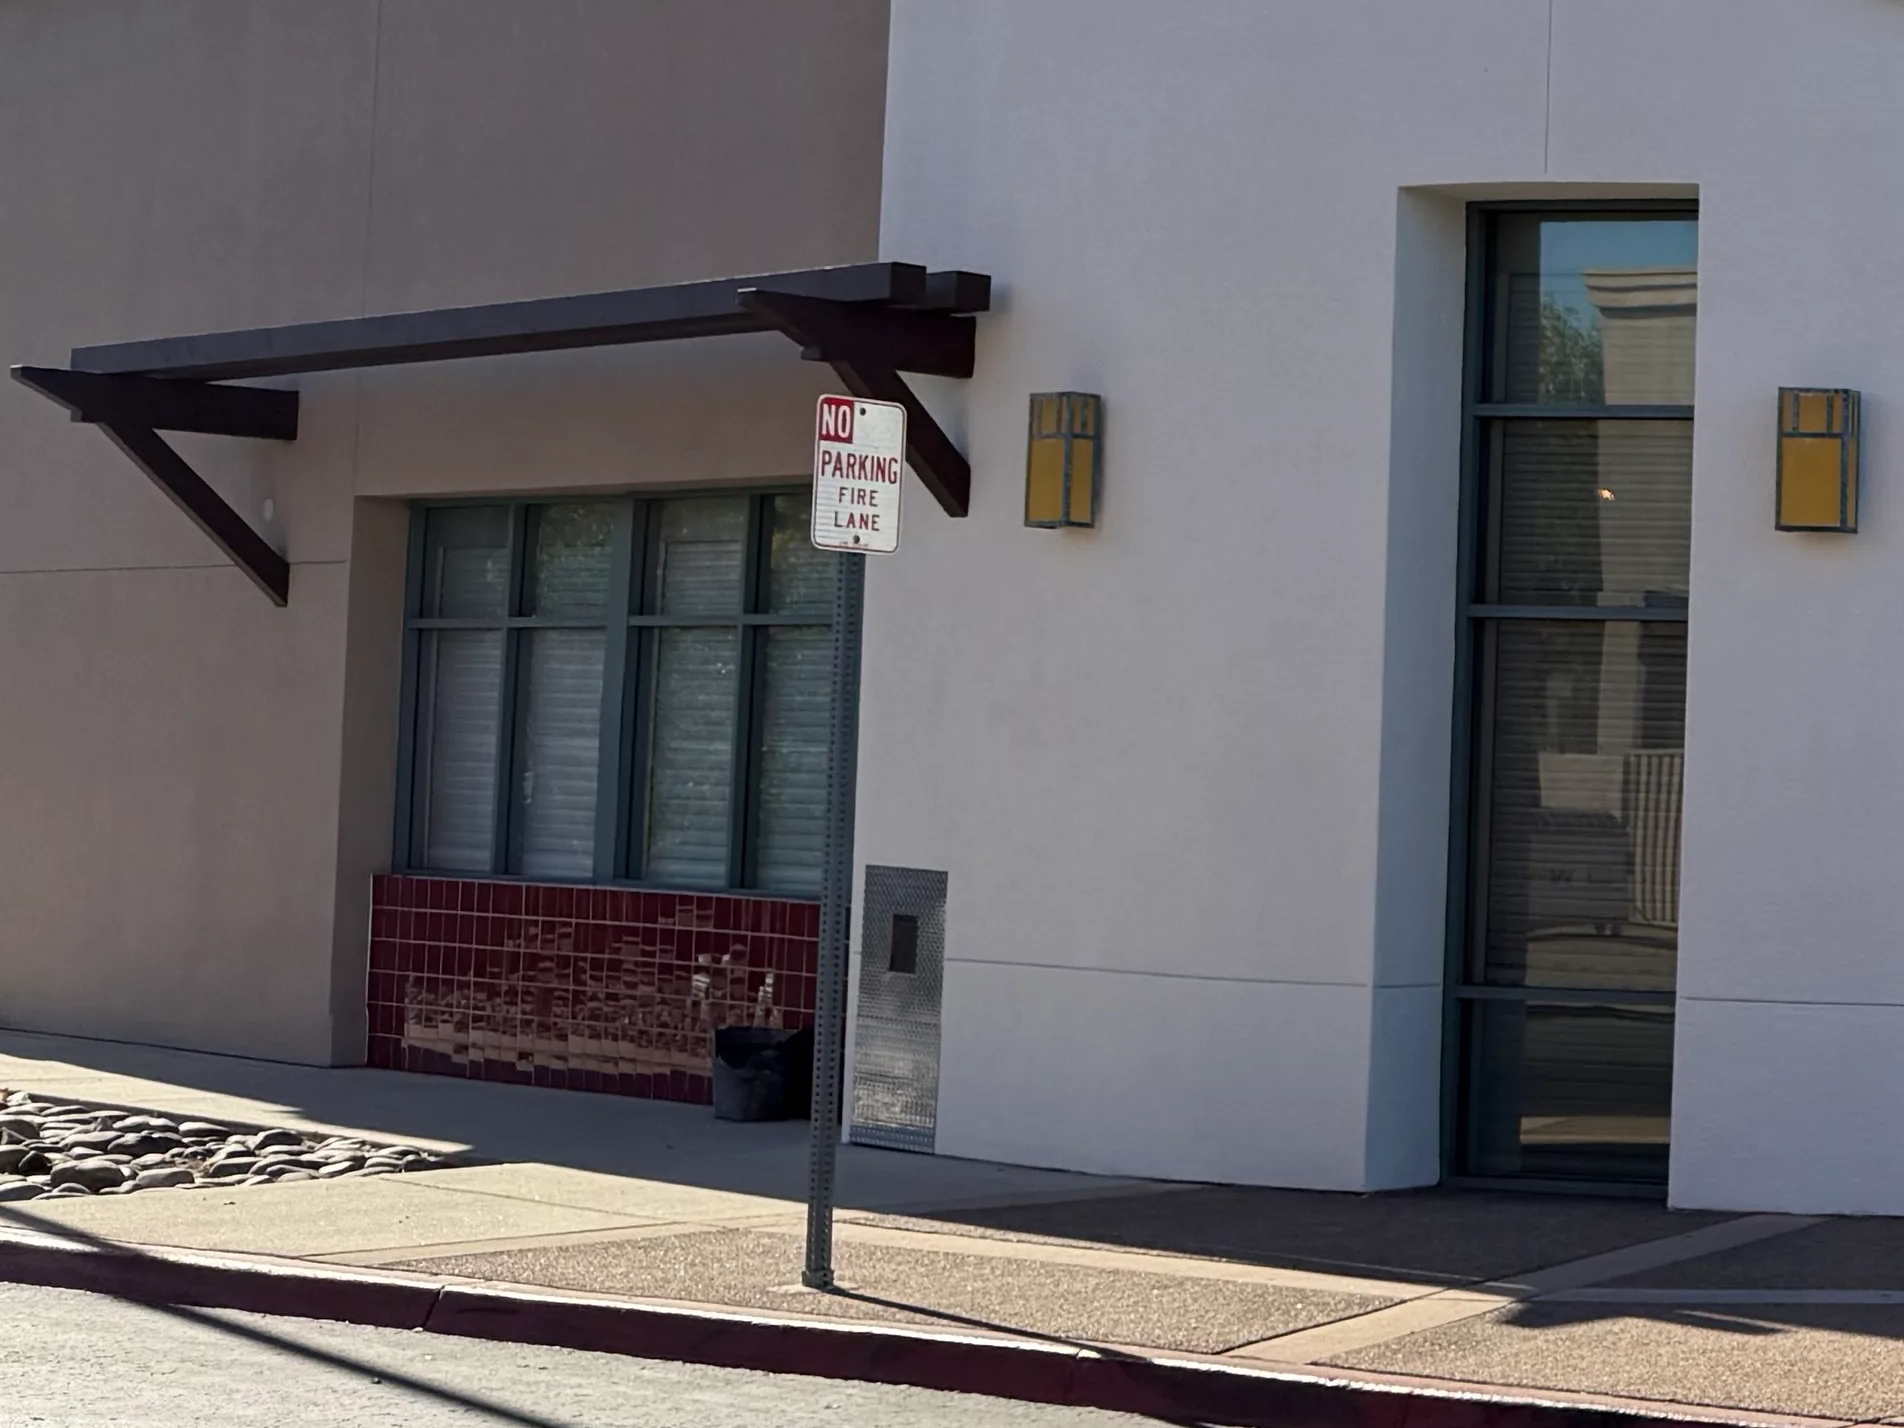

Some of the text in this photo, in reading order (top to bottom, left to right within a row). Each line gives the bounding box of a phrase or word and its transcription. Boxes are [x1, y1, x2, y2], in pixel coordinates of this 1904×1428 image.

[821, 403, 852, 439] NO
[820, 450, 899, 484] PARKING
[838, 486, 879, 507] FIRE
[833, 510, 880, 532] LANE
